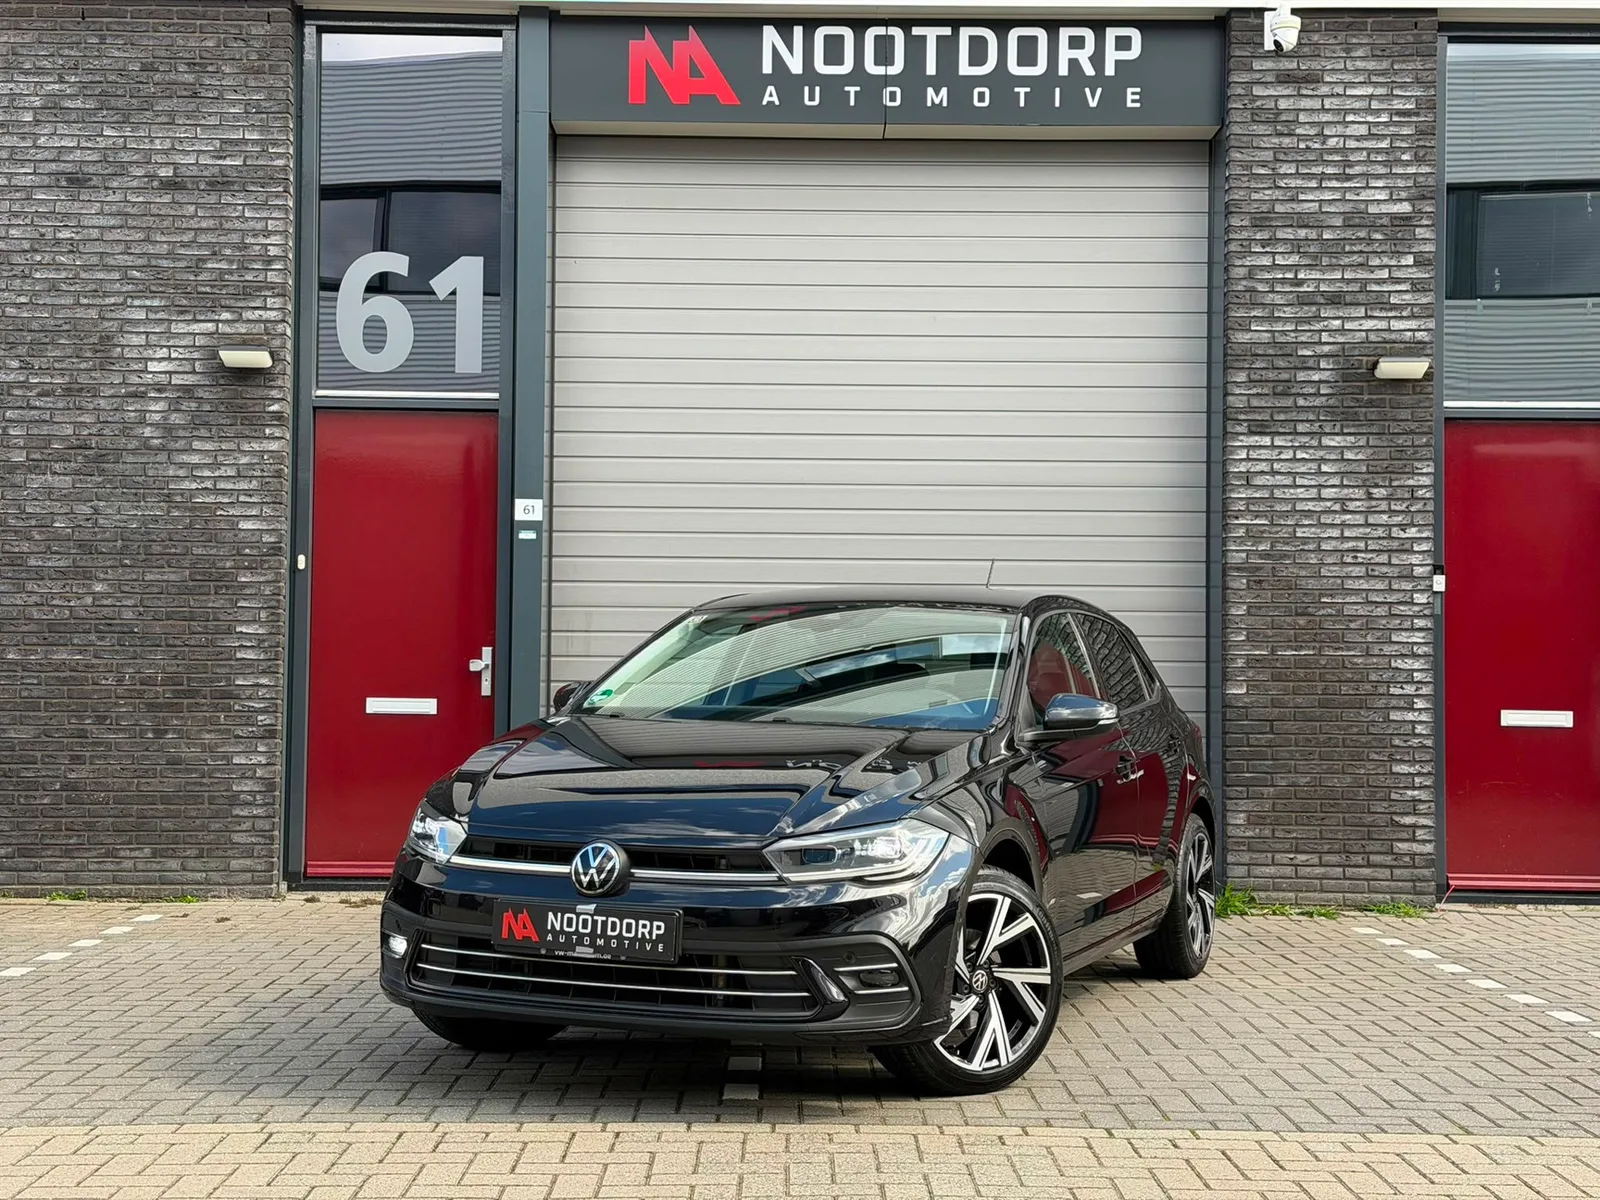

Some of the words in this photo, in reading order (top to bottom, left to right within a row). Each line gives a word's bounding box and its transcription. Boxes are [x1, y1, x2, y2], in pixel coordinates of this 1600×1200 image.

[762, 25, 1142, 76] NOOTDORP
[761, 85, 1142, 108] AUTOMOTIVE
[335, 251, 484, 373] 61
[523, 504, 535, 515] 61
[547, 911, 665, 940] NOOTDORP
[546, 933, 664, 952] AUTOMOTIVE
